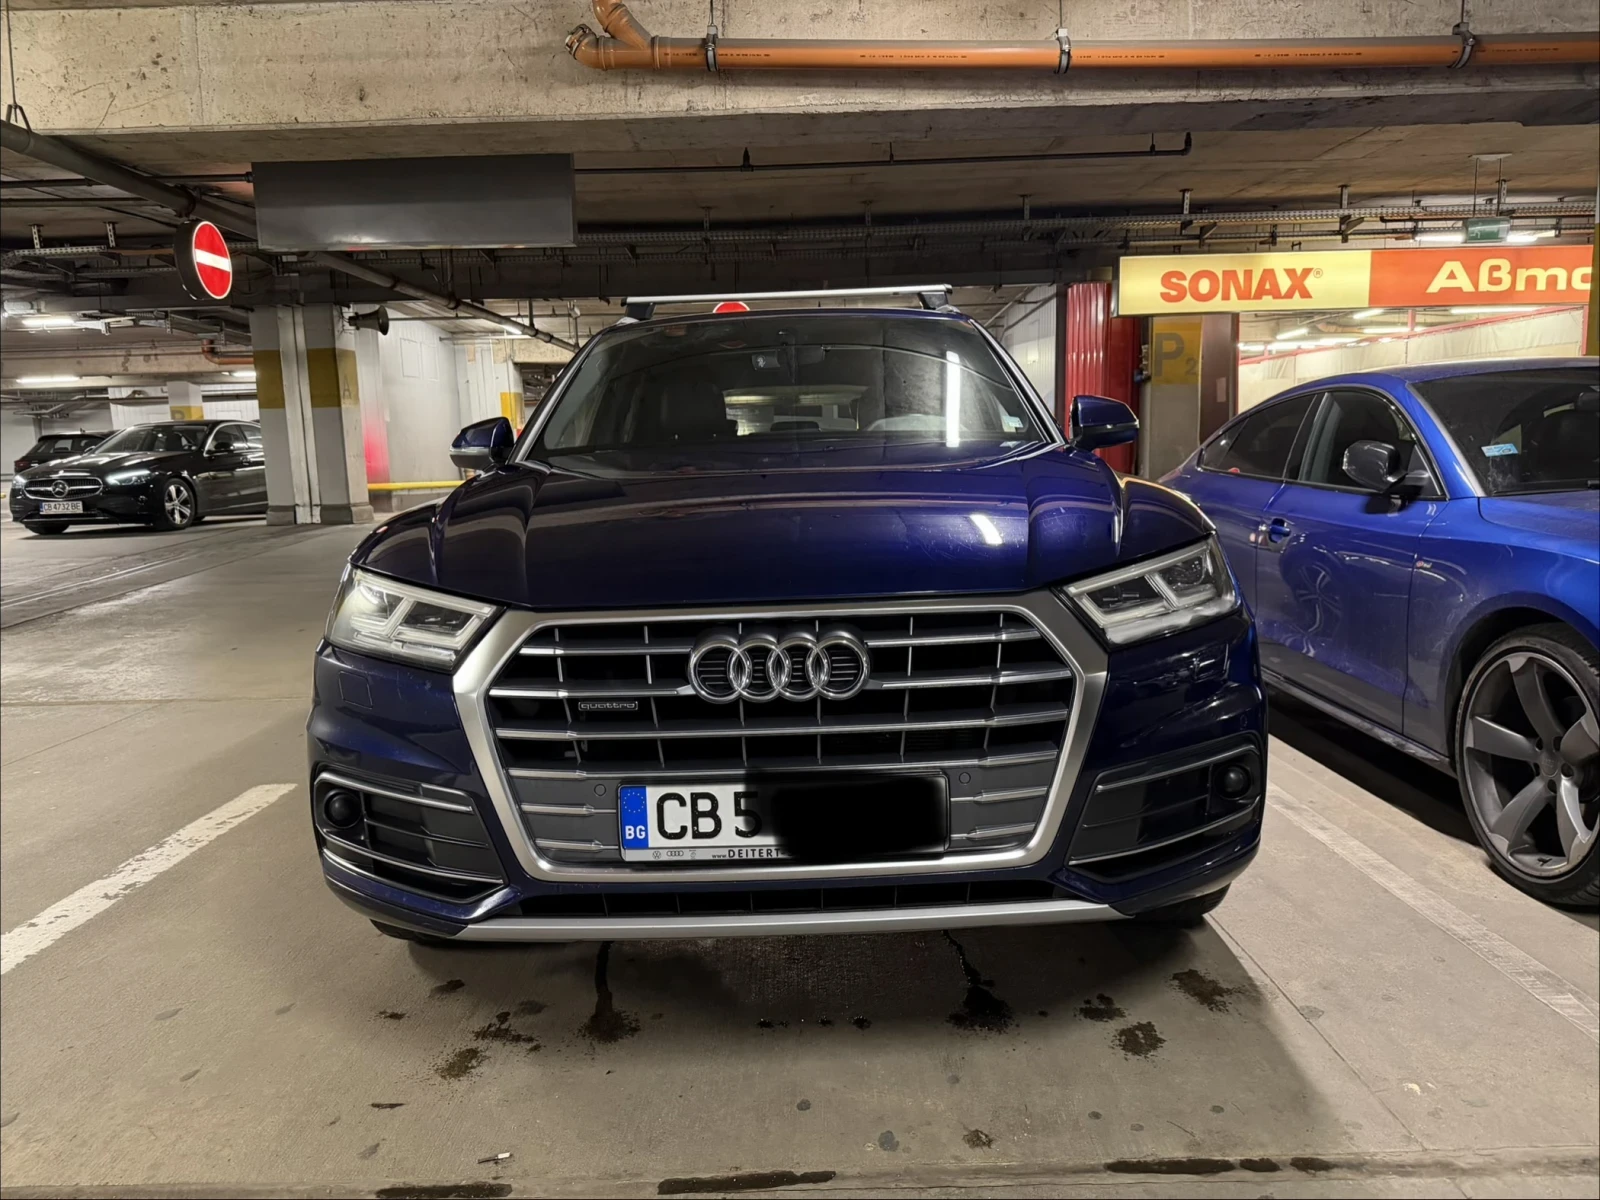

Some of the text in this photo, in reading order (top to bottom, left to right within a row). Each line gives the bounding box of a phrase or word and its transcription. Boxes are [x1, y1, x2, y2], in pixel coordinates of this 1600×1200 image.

[580, 702, 636, 710] quattro
[656, 791, 722, 840] CB
[625, 825, 646, 840] BG
